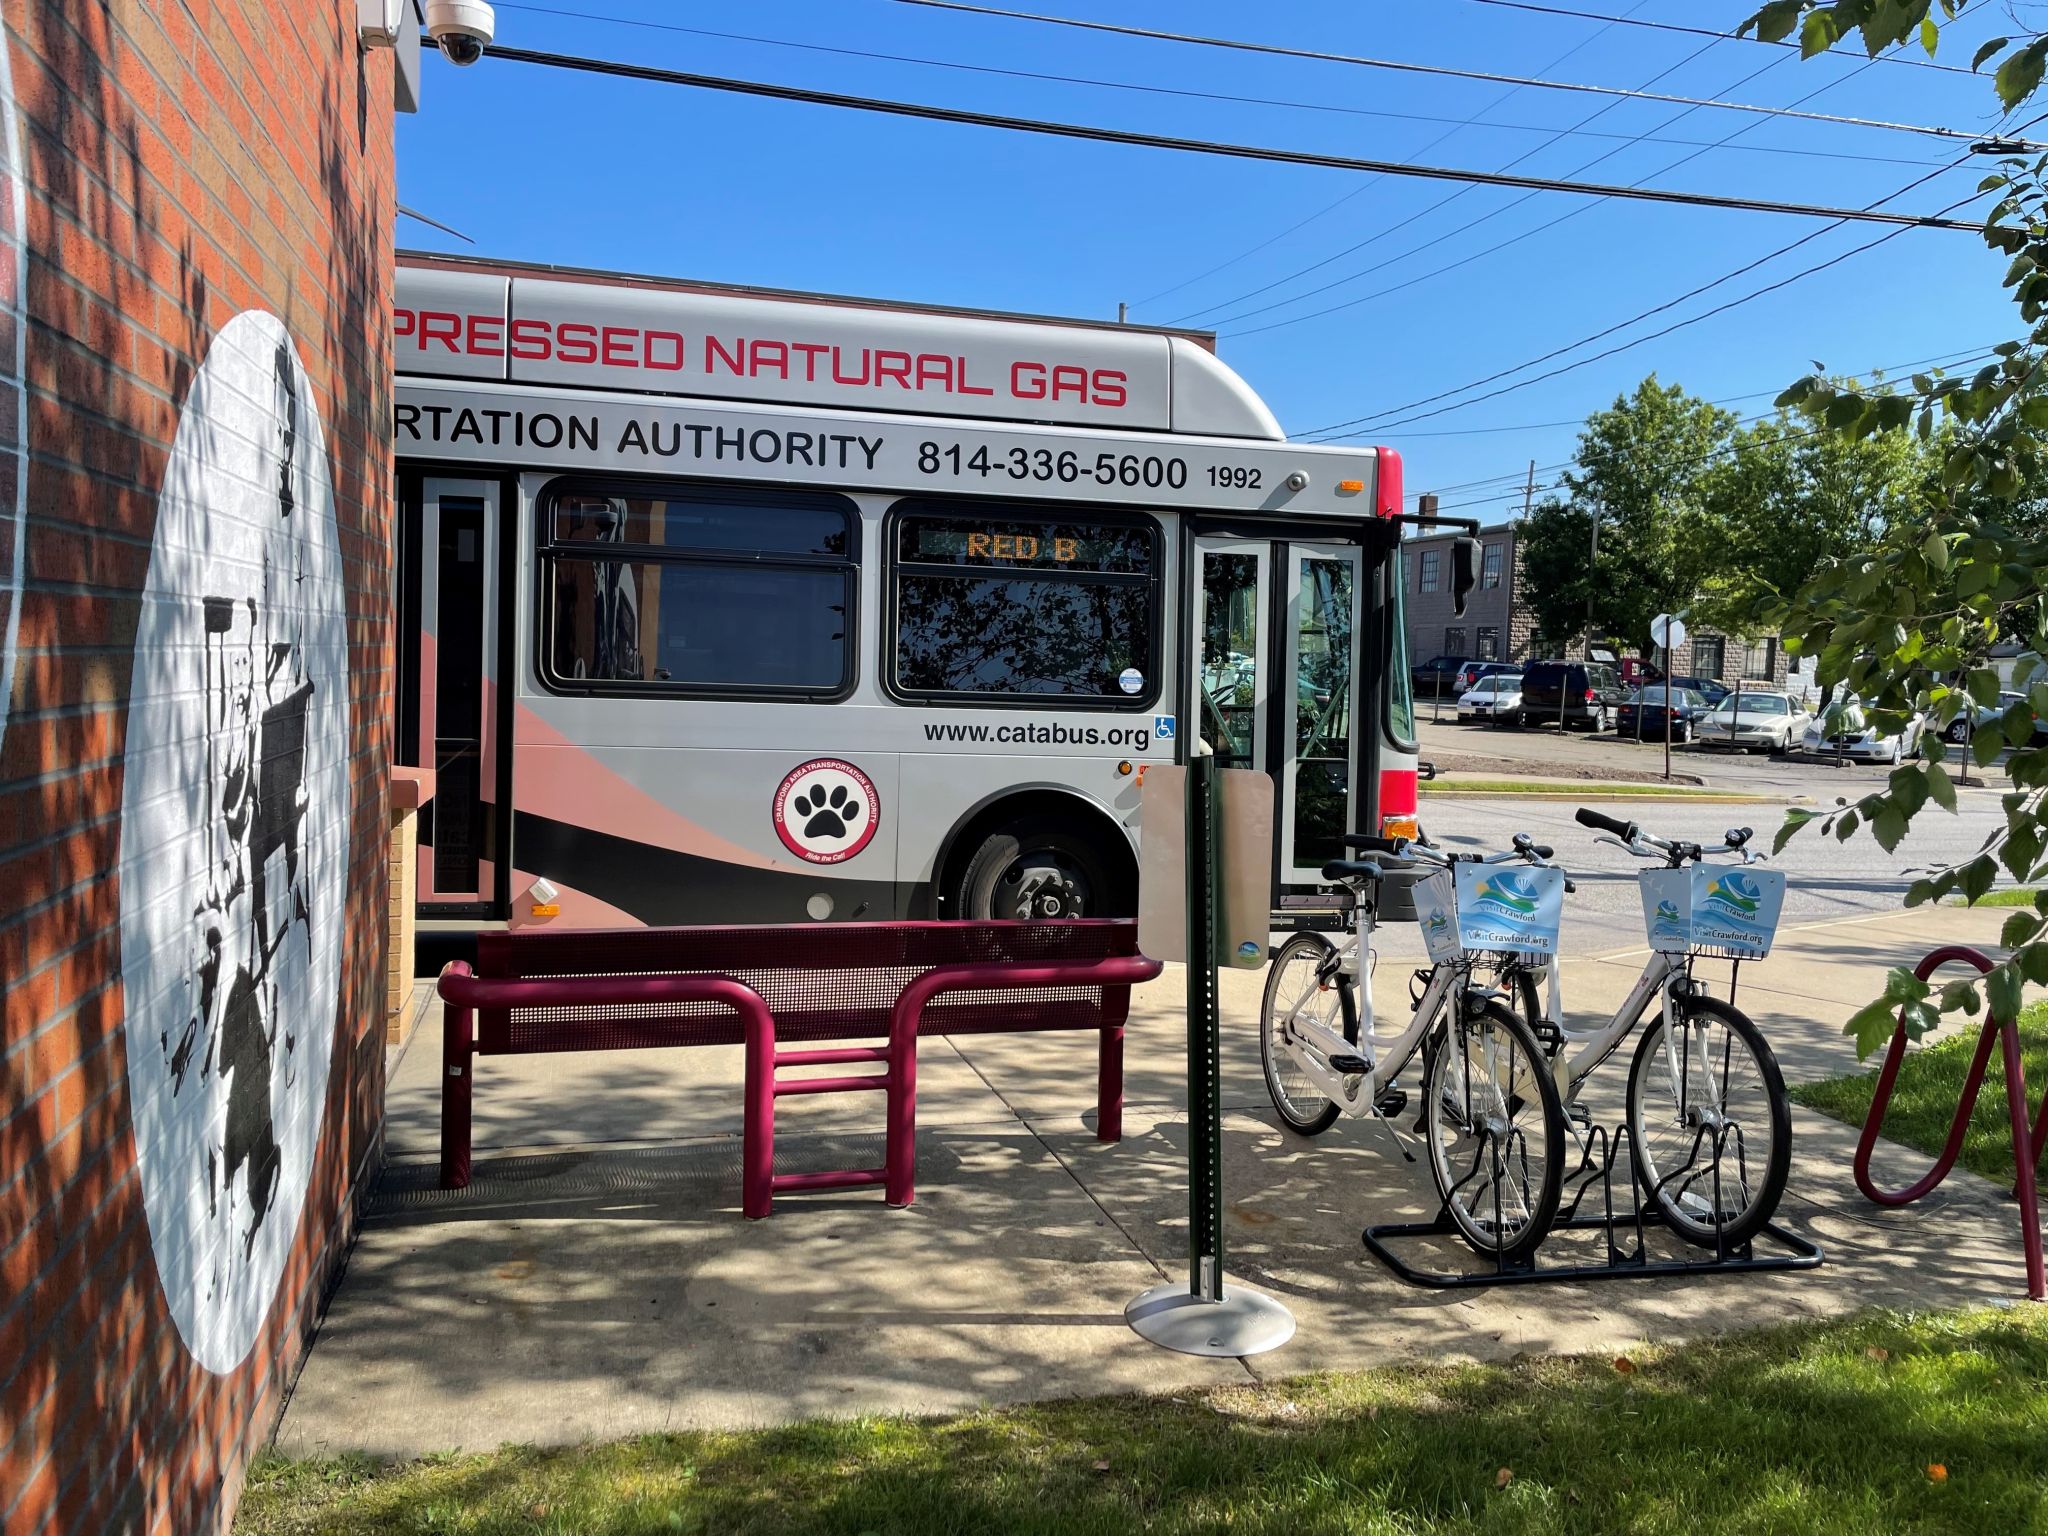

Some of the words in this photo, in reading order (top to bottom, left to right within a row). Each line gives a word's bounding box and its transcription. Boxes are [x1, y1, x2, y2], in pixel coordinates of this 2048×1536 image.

[705, 335, 994, 396] NATURAL
[1010, 361, 1128, 407] GAS
[394, 403, 599, 451] RTATION
[617, 419, 884, 470] AUTHORITY
[917, 440, 1188, 490] 814-336-5600
[1206, 465, 1262, 490] 1992
[967, 532, 1038, 561] RED
[1054, 537, 1077, 561] B
[924, 721, 1150, 751] www.catabus.org
[776, 782, 791, 823] CRAWFORD
[790, 768, 808, 784] AREA
[806, 761, 867, 785] TRANSPORTATION
[864, 784, 877, 824] AUTHORITY
[1694, 926, 1763, 946] VisitCrawford.org
